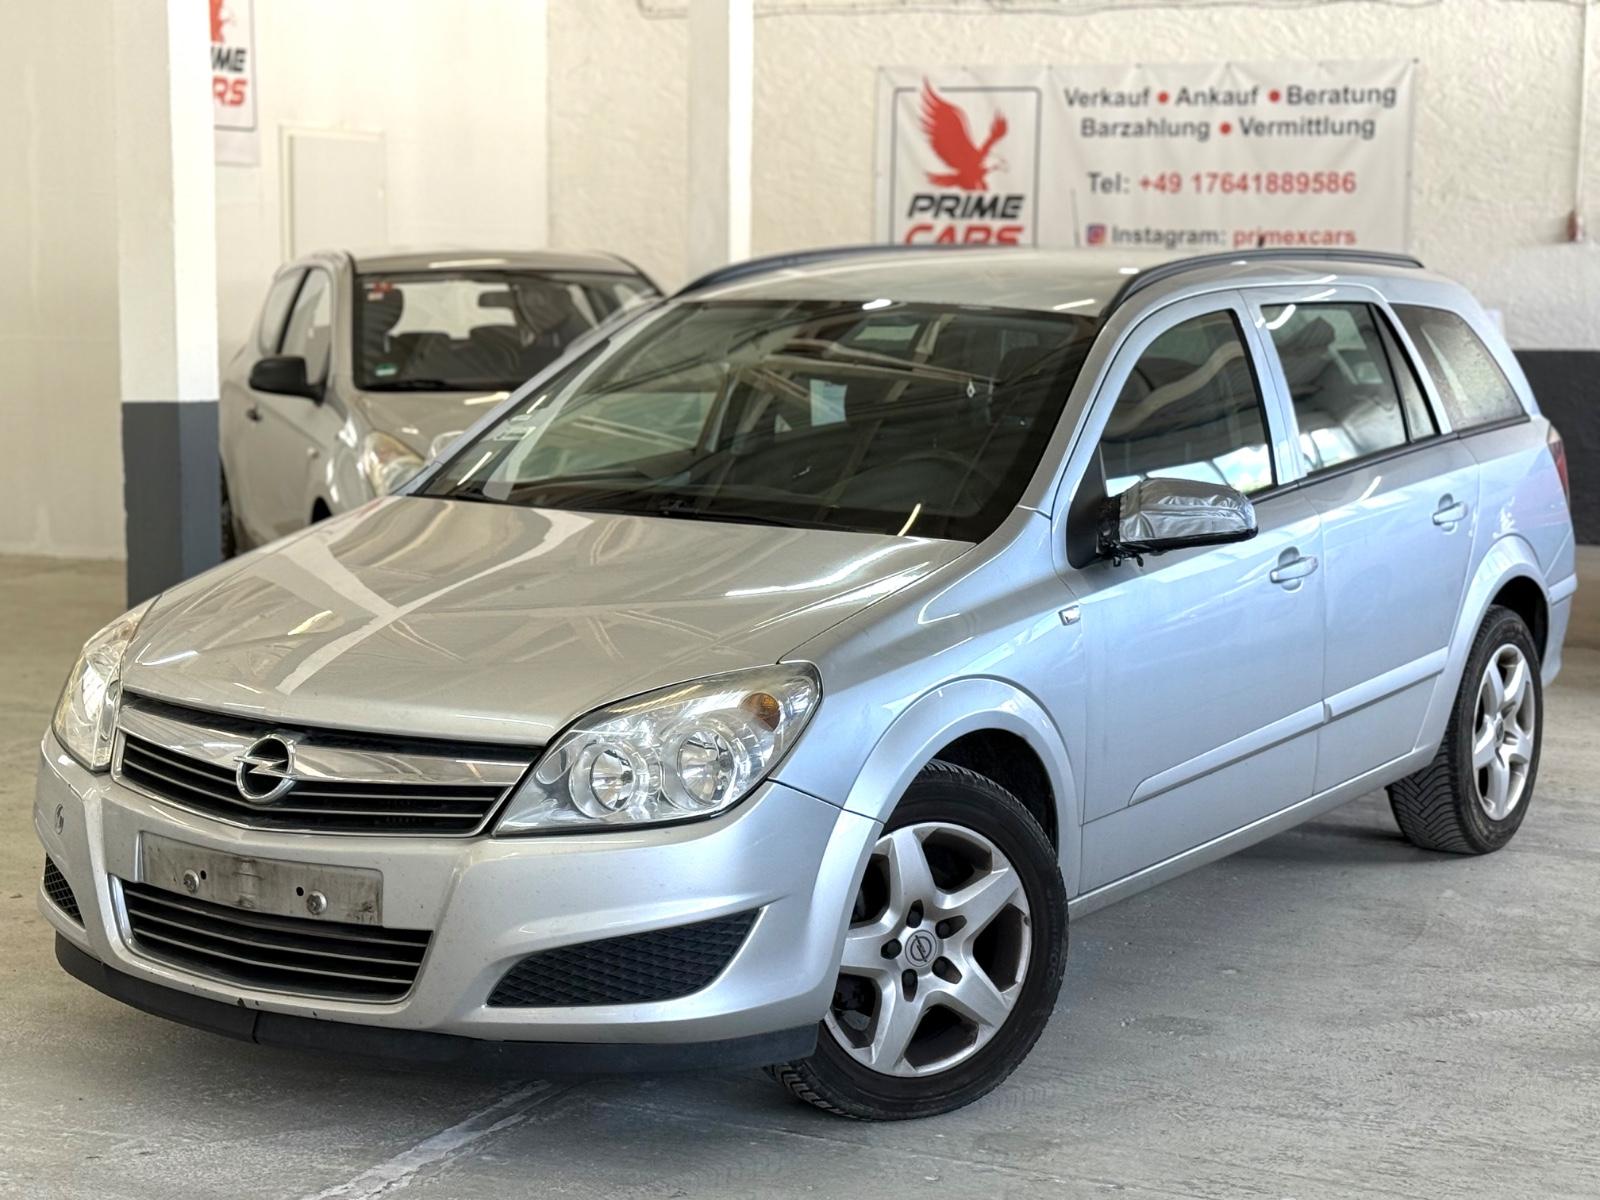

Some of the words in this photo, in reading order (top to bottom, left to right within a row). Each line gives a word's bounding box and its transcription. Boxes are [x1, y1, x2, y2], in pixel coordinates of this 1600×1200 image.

[1064, 86, 1150, 107] Verkauf
[1174, 85, 1260, 107] Ankauf
[1286, 84, 1397, 108] Beratung
[1080, 117, 1210, 142] Barzahlung
[1238, 115, 1376, 139] Vermittlung
[1087, 172, 1130, 194] Tel:
[1138, 172, 1182, 194] +49
[1192, 170, 1357, 194] 17641889586
[907, 193, 1025, 219] PRIME
[1111, 226, 1226, 248] Instagram:
[1232, 227, 1357, 247] primexcars
